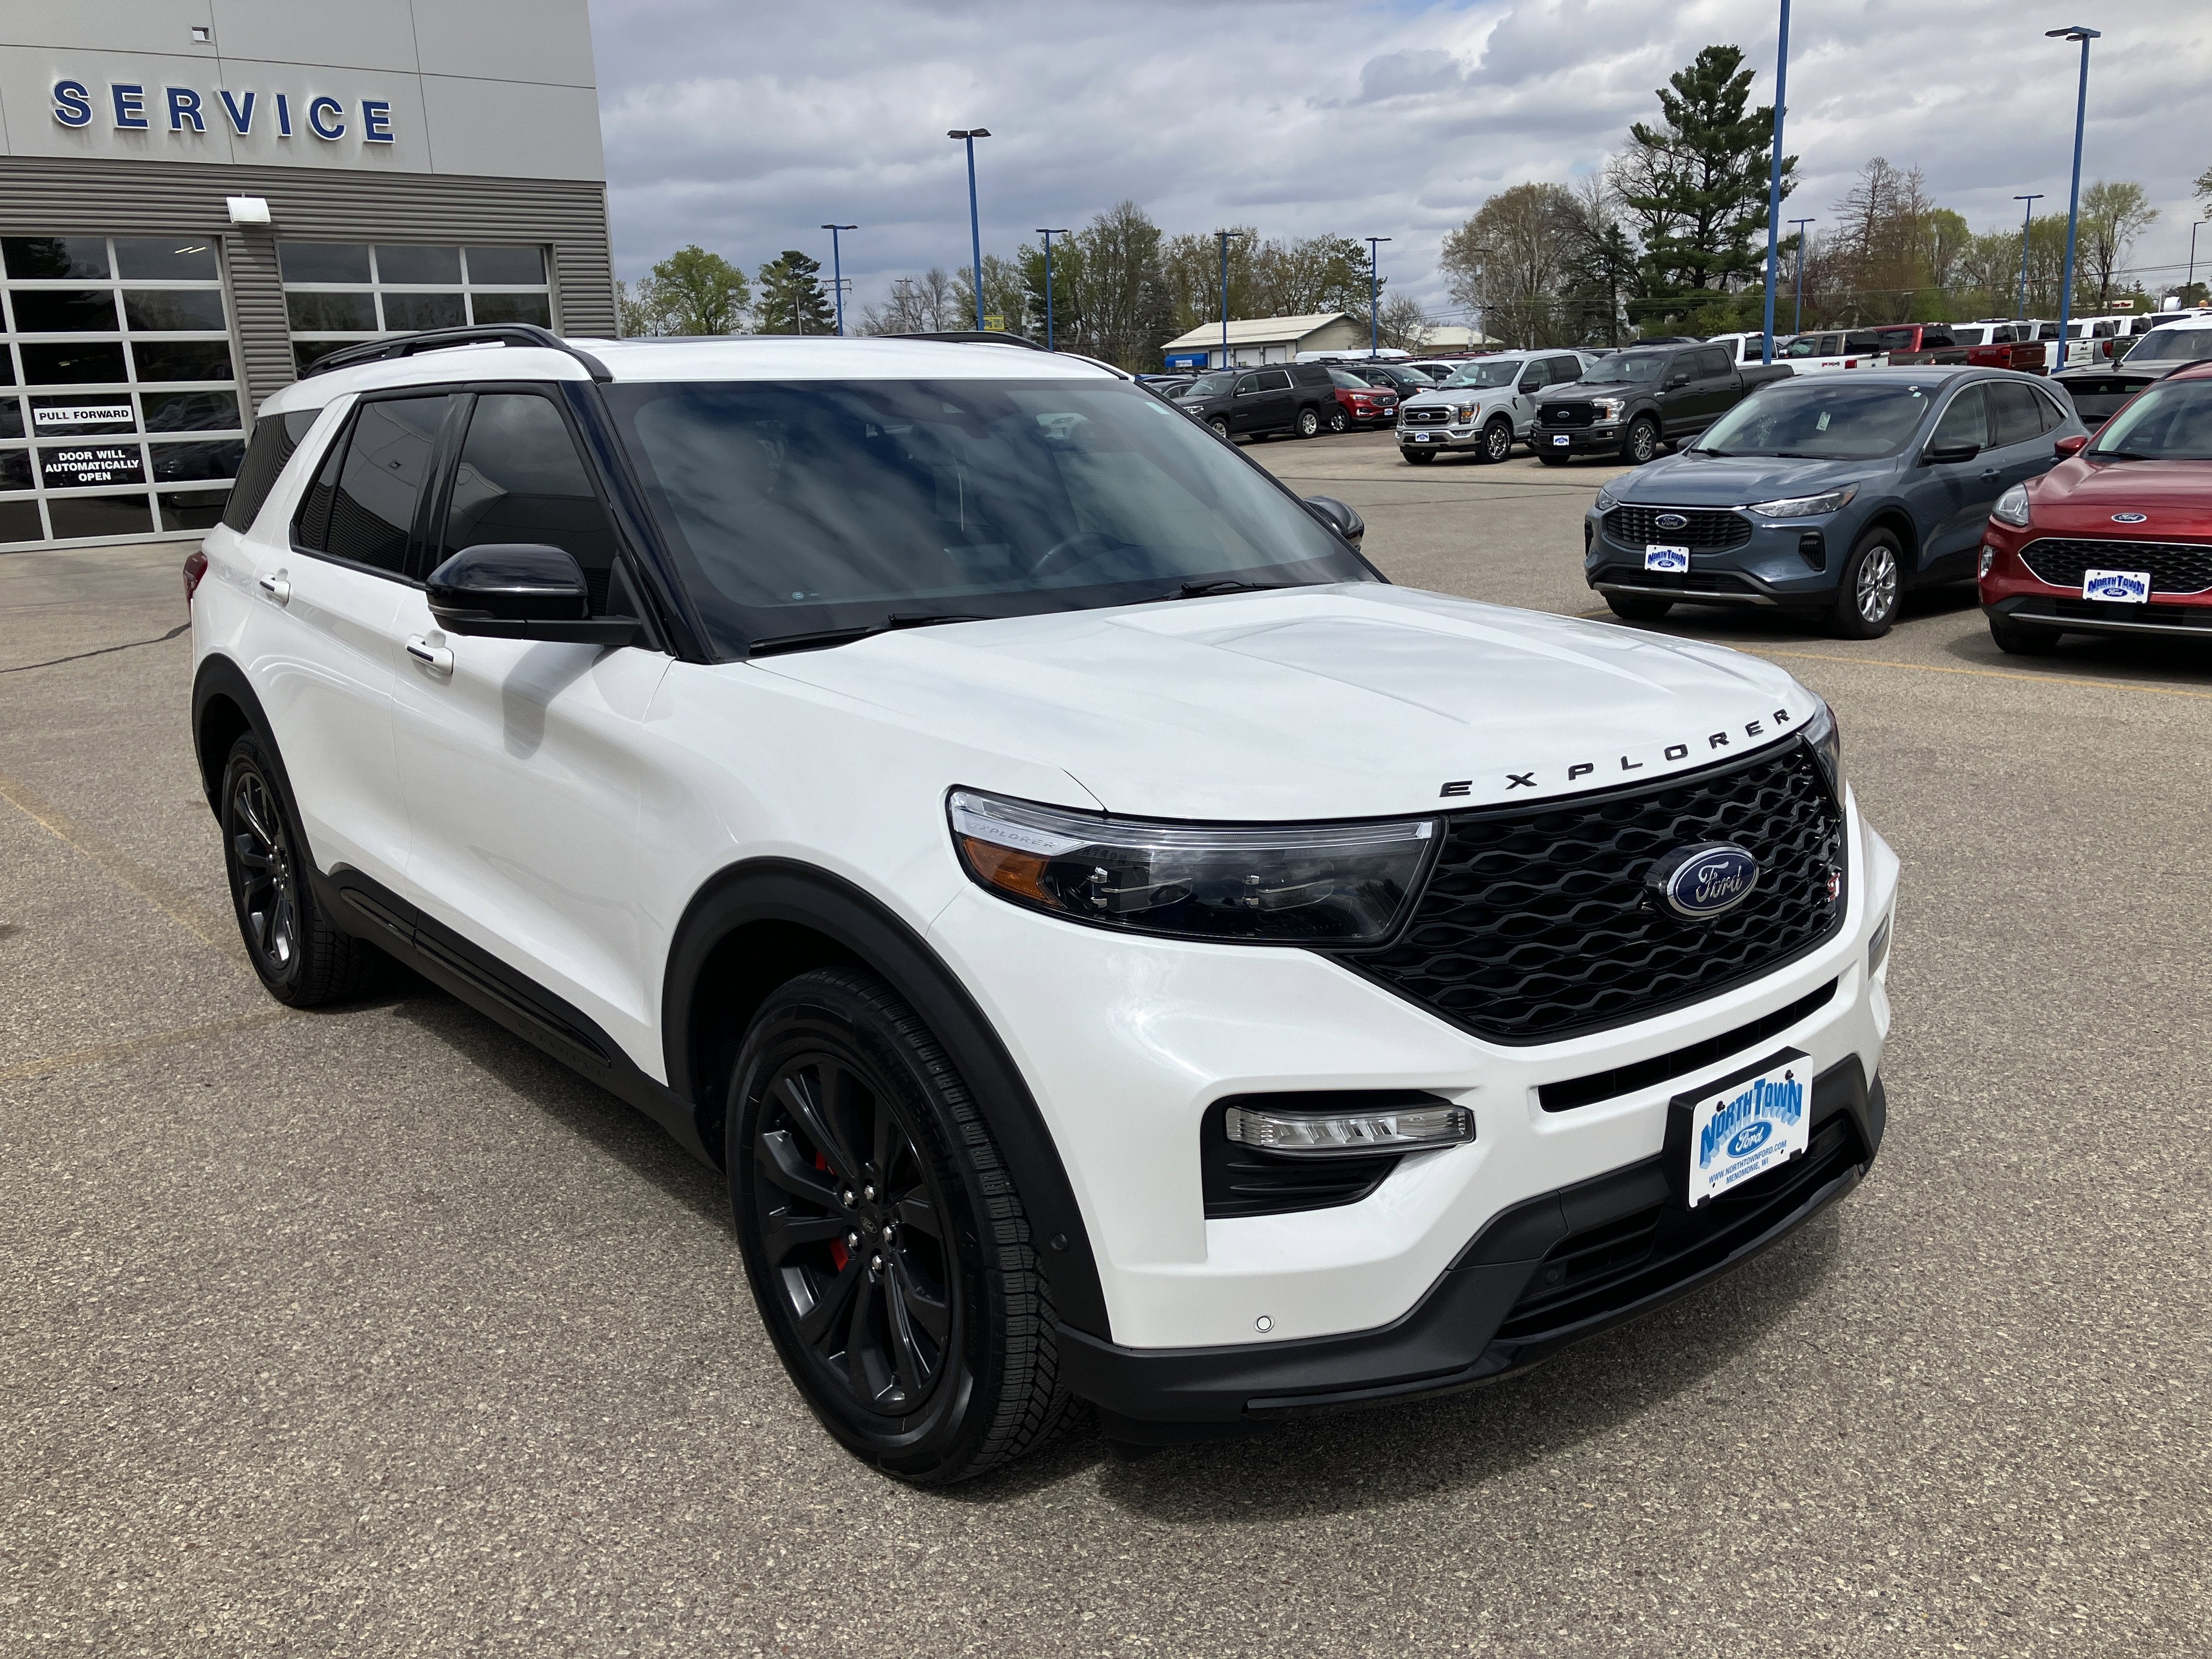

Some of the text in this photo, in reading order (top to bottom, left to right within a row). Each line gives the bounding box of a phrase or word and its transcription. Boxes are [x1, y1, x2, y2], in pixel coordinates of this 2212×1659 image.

[53, 80, 395, 143] SERVICE
[40, 410, 129, 420] PULL FORWARD
[45, 460, 139, 472] AUTOMATICALLY
[59, 450, 126, 461] DOOR WILL
[78, 472, 111, 481] OPEN
[1439, 708, 1791, 798] EXPLORER
[970, 822, 1057, 849] EXPLORER
[1696, 861, 1743, 903] Ford
[1735, 1125, 1764, 1153] Ford
[1708, 1139, 1787, 1184] WWW.NORTHTOWNFORD.COM
[1726, 1157, 1769, 1184] MENOMONIE, WI
